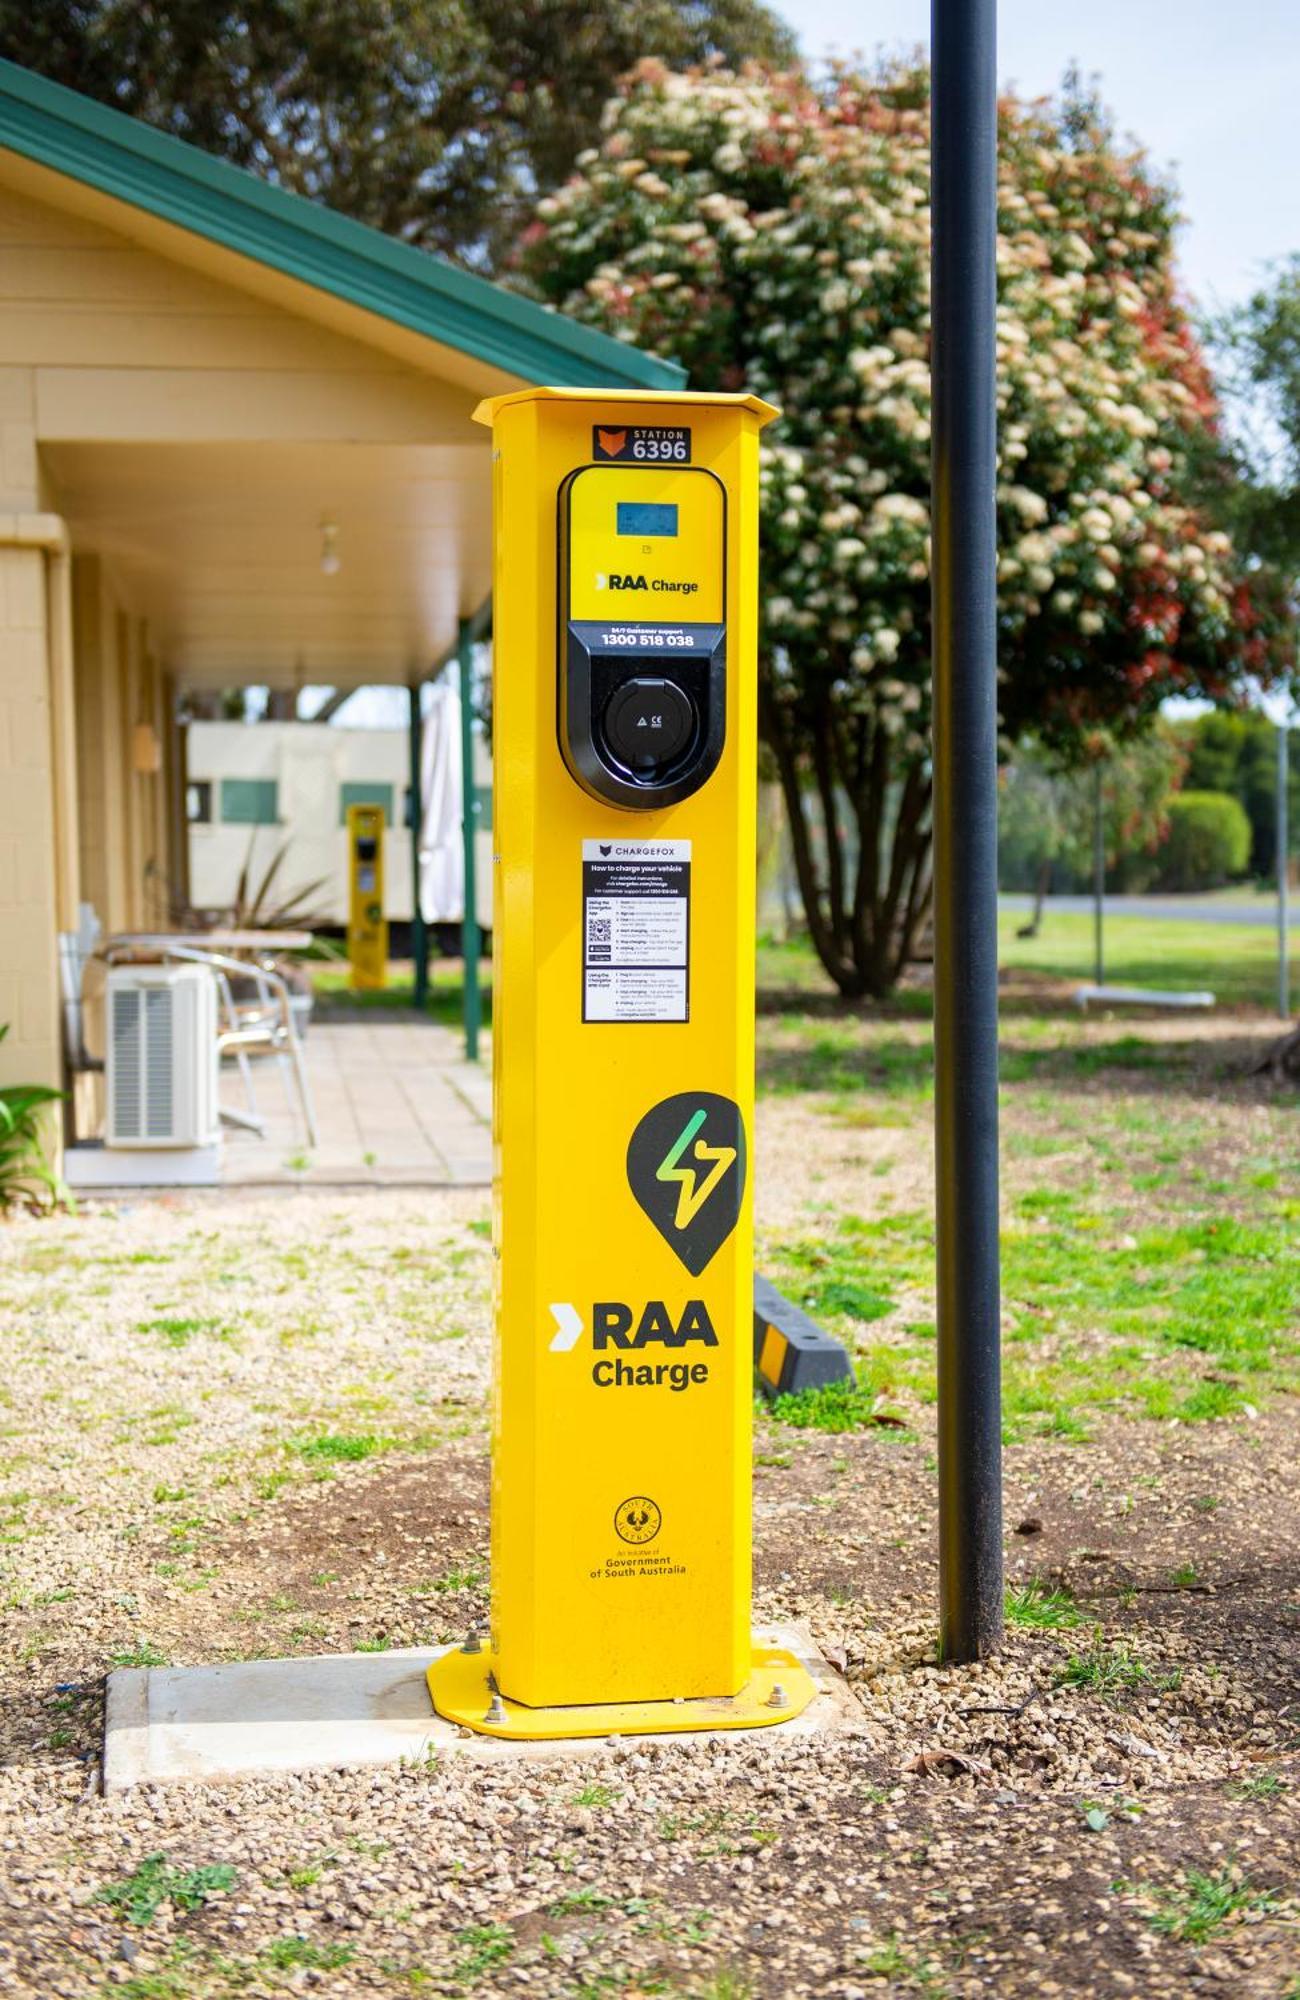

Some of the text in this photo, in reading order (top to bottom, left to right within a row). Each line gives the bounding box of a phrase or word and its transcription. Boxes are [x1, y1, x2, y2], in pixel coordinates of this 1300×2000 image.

[633, 430, 684, 440] STATION
[633, 441, 687, 459] 6396
[608, 574, 698, 594] RAA Charge
[602, 634, 694, 646] 1300 518 038
[615, 847, 674, 856] CHARGEFOX
[616, 865, 640, 873] charge
[593, 1300, 719, 1349] RAA
[592, 1358, 709, 1392] Charge
[606, 1557, 671, 1567] Government
[590, 1565, 686, 1578] of South Australia
